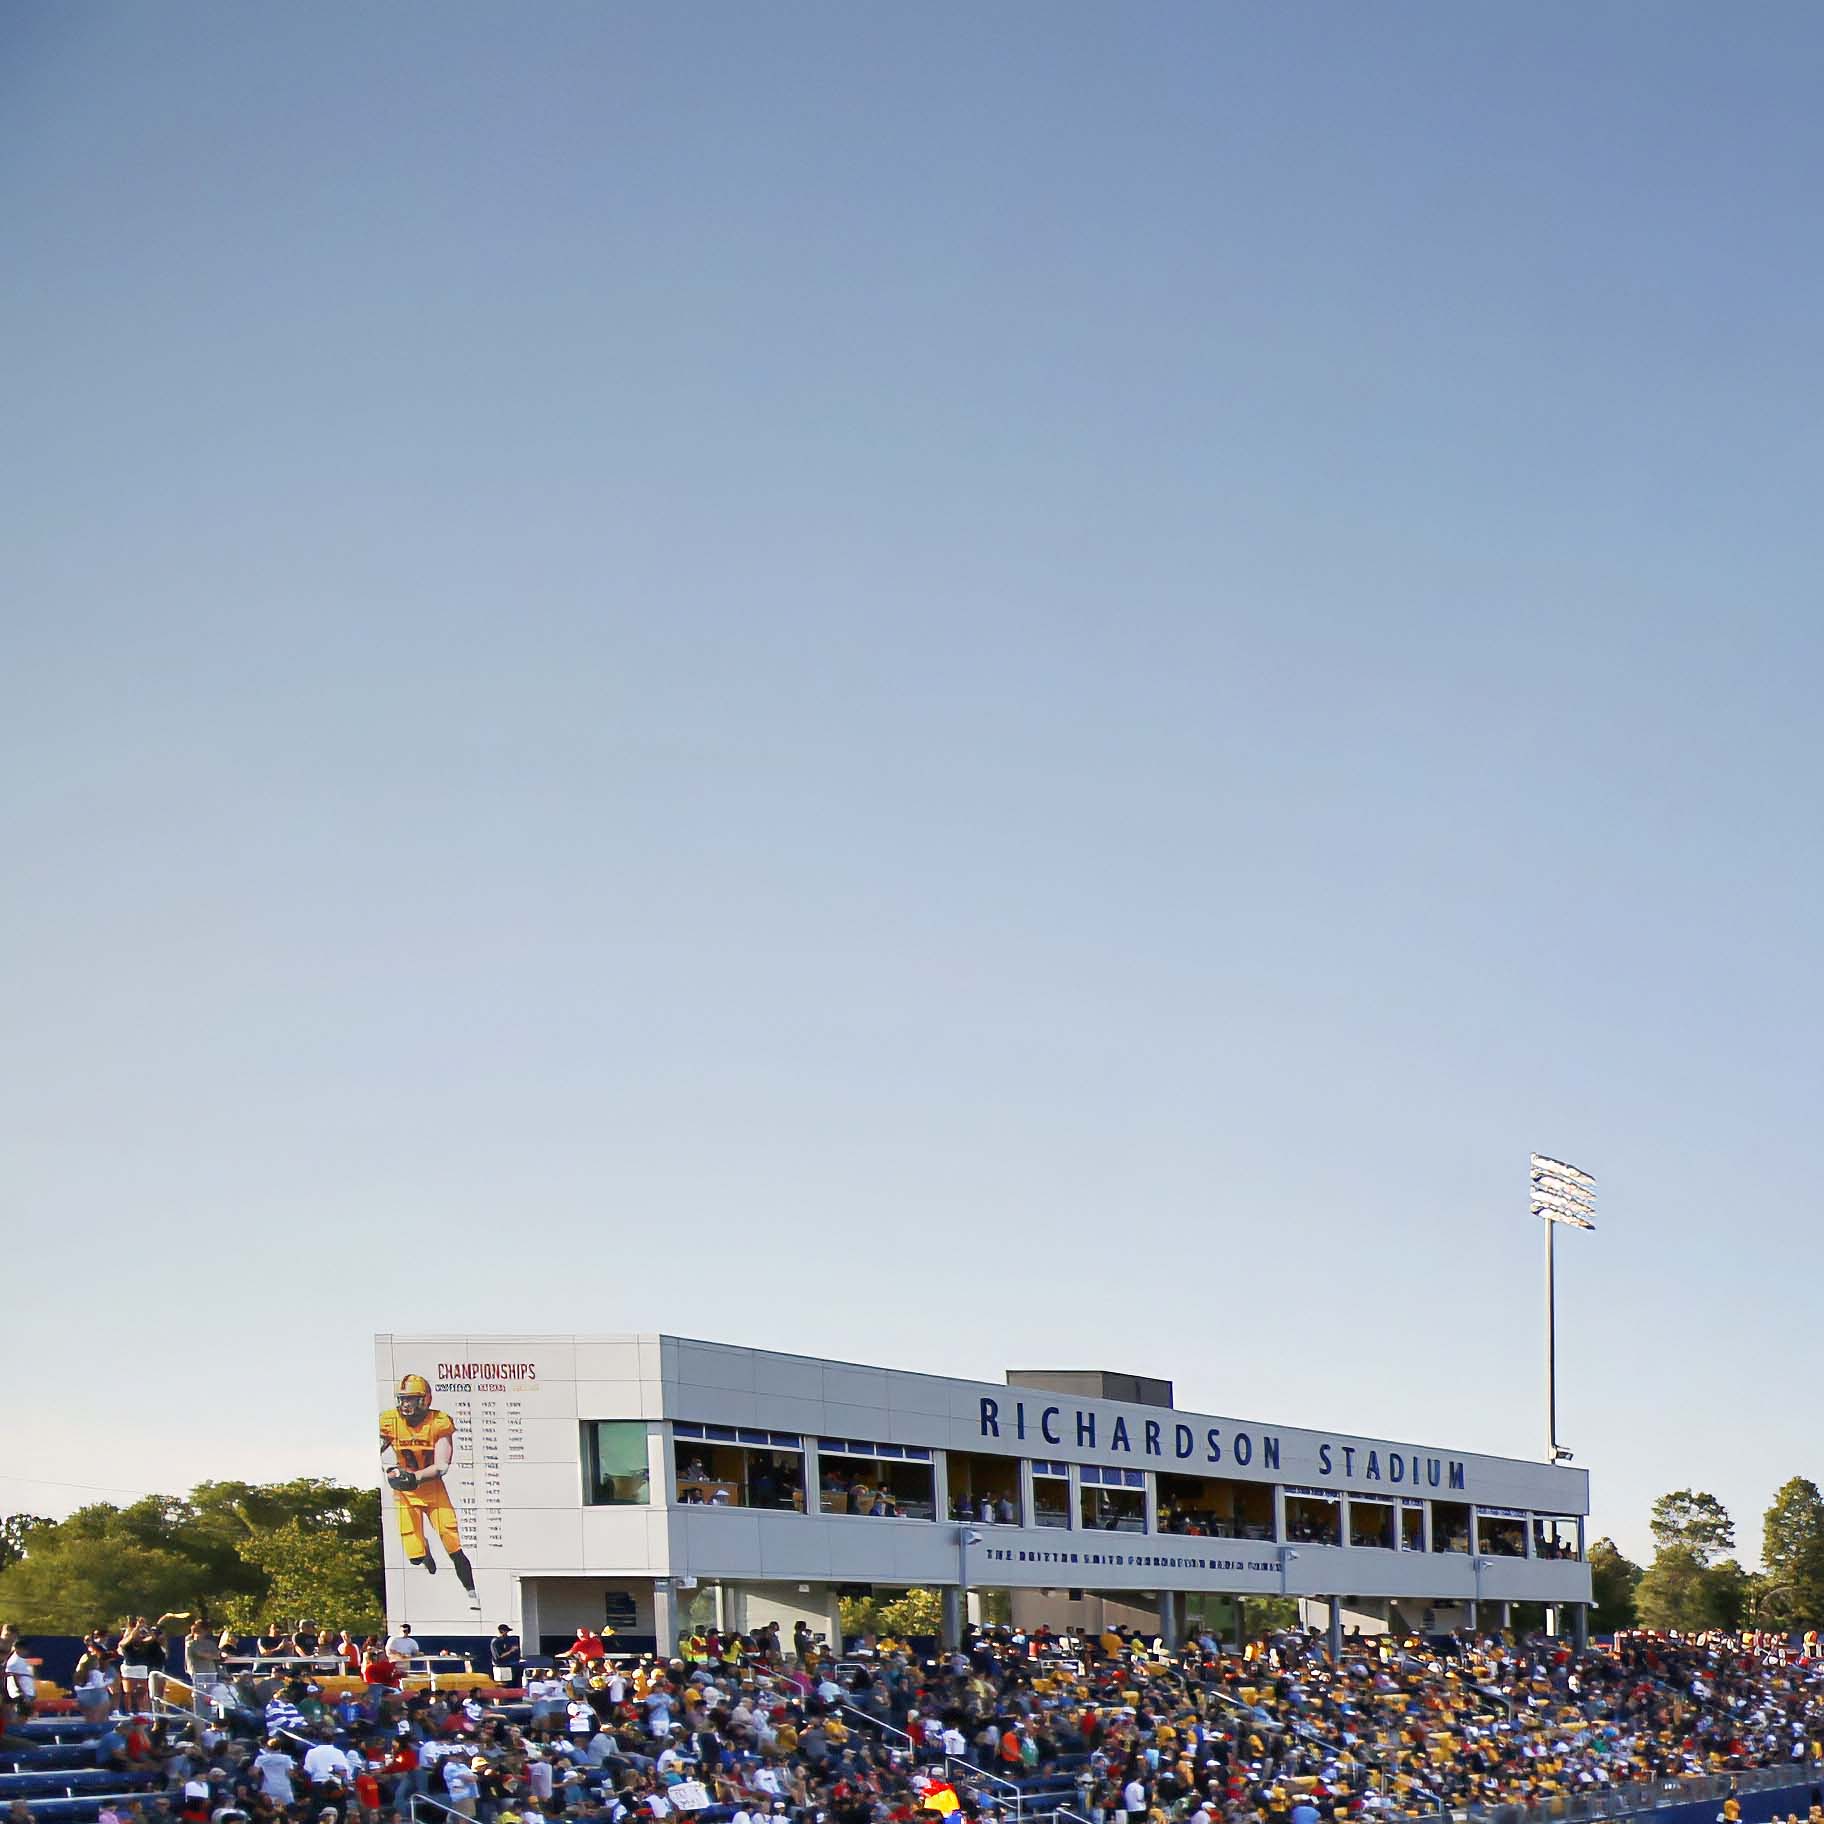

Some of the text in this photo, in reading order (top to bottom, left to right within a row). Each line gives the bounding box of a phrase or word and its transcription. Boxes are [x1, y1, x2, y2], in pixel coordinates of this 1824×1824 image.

[438, 1363, 536, 1379] CHAMPIONSHIPS
[980, 1398, 1465, 1490] RICHARDSON STADIUM
